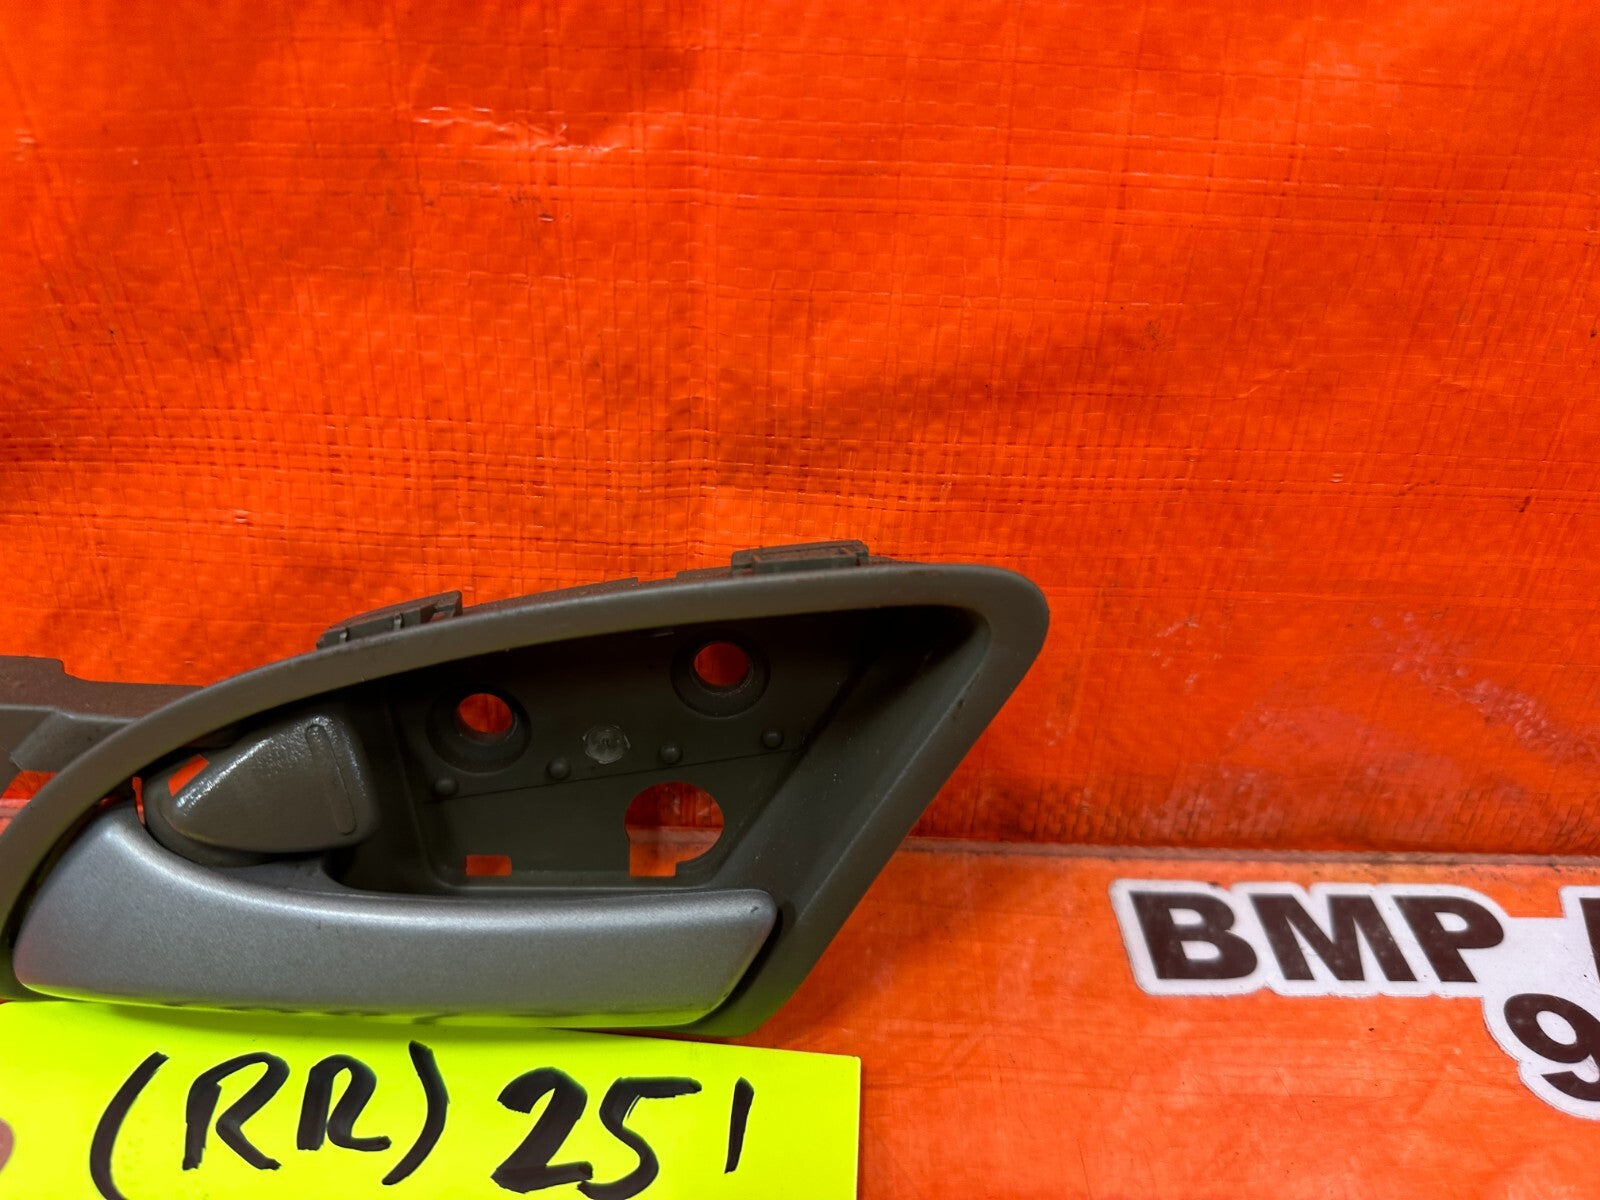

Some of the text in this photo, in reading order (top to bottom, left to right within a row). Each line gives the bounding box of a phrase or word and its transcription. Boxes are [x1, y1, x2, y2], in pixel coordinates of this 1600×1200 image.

[1129, 891, 1505, 983] BMP
[89, 1040, 755, 1200] (RR) 251
